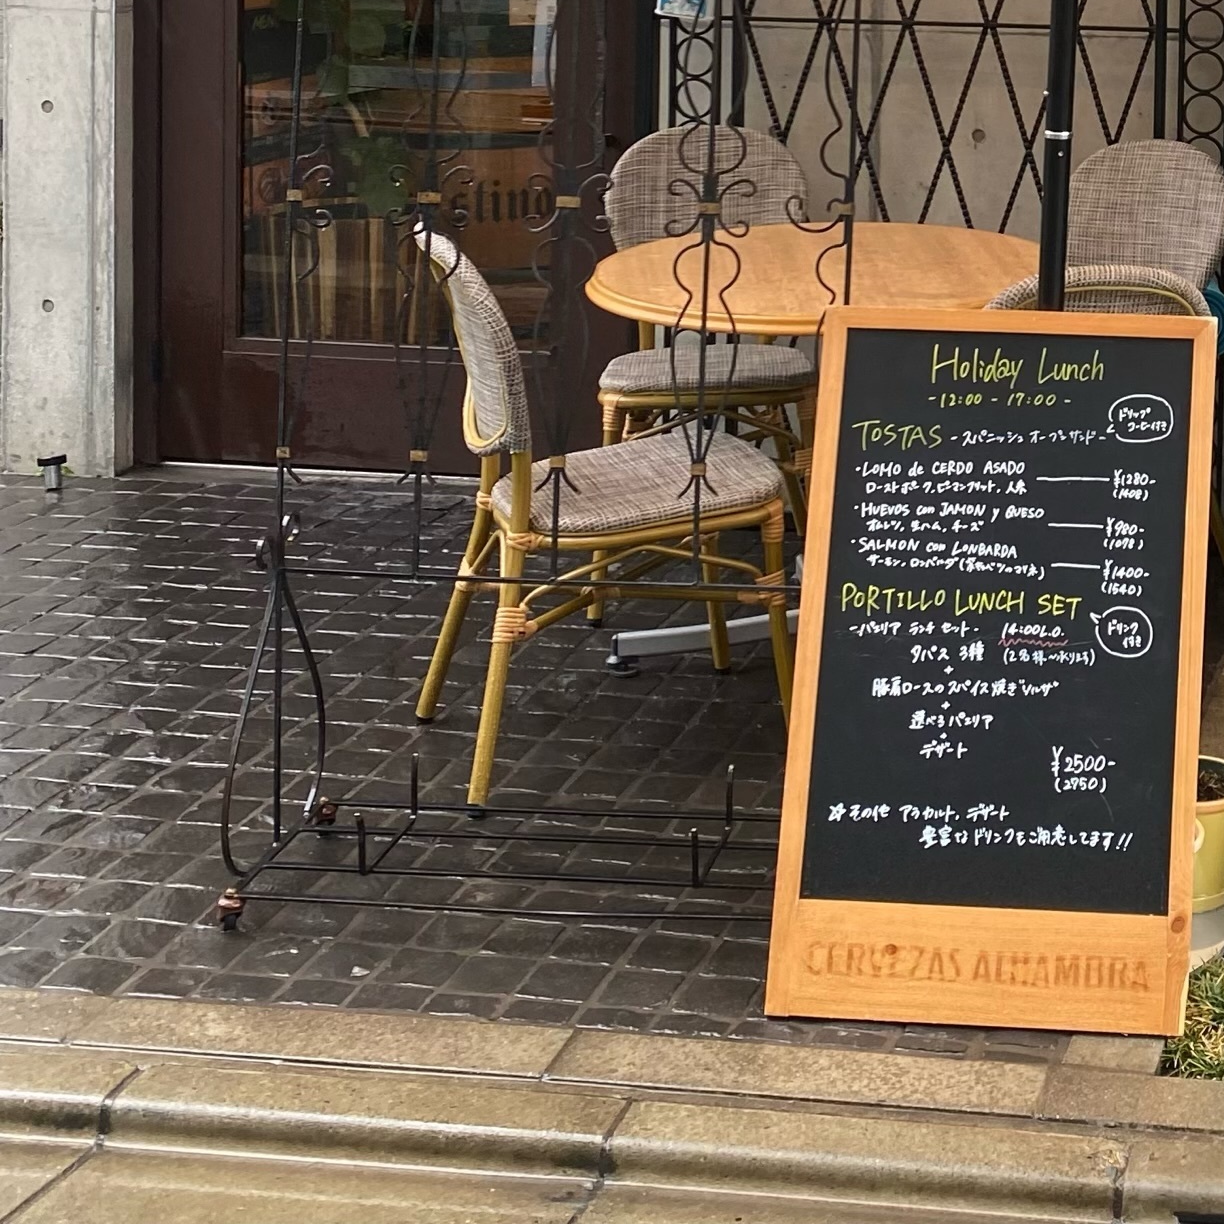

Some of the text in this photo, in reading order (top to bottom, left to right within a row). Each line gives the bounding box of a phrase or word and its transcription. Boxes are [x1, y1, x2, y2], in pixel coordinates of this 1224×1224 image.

[931, 344, 1105, 389] Holiday Lunch
[1007, 392, 1057, 408] 17:00
[852, 419, 942, 451] TOSTAS
[862, 460, 1026, 477] LOMO de CERDO ASADO
[1112, 489, 1149, 501] (1408)
[860, 502, 1045, 523] HUEVOS con JAMON y QUESO
[858, 537, 1018, 559] SALMON con LONBARDA
[1103, 538, 1144, 551] (1078)
[1101, 581, 1143, 597] (1540)
[841, 582, 1082, 620] PORTILLO LUNCH SET
[1108, 619, 1139, 635] ドリンク
[919, 739, 969, 759] デザート
[1054, 777, 1107, 793] (2750)
